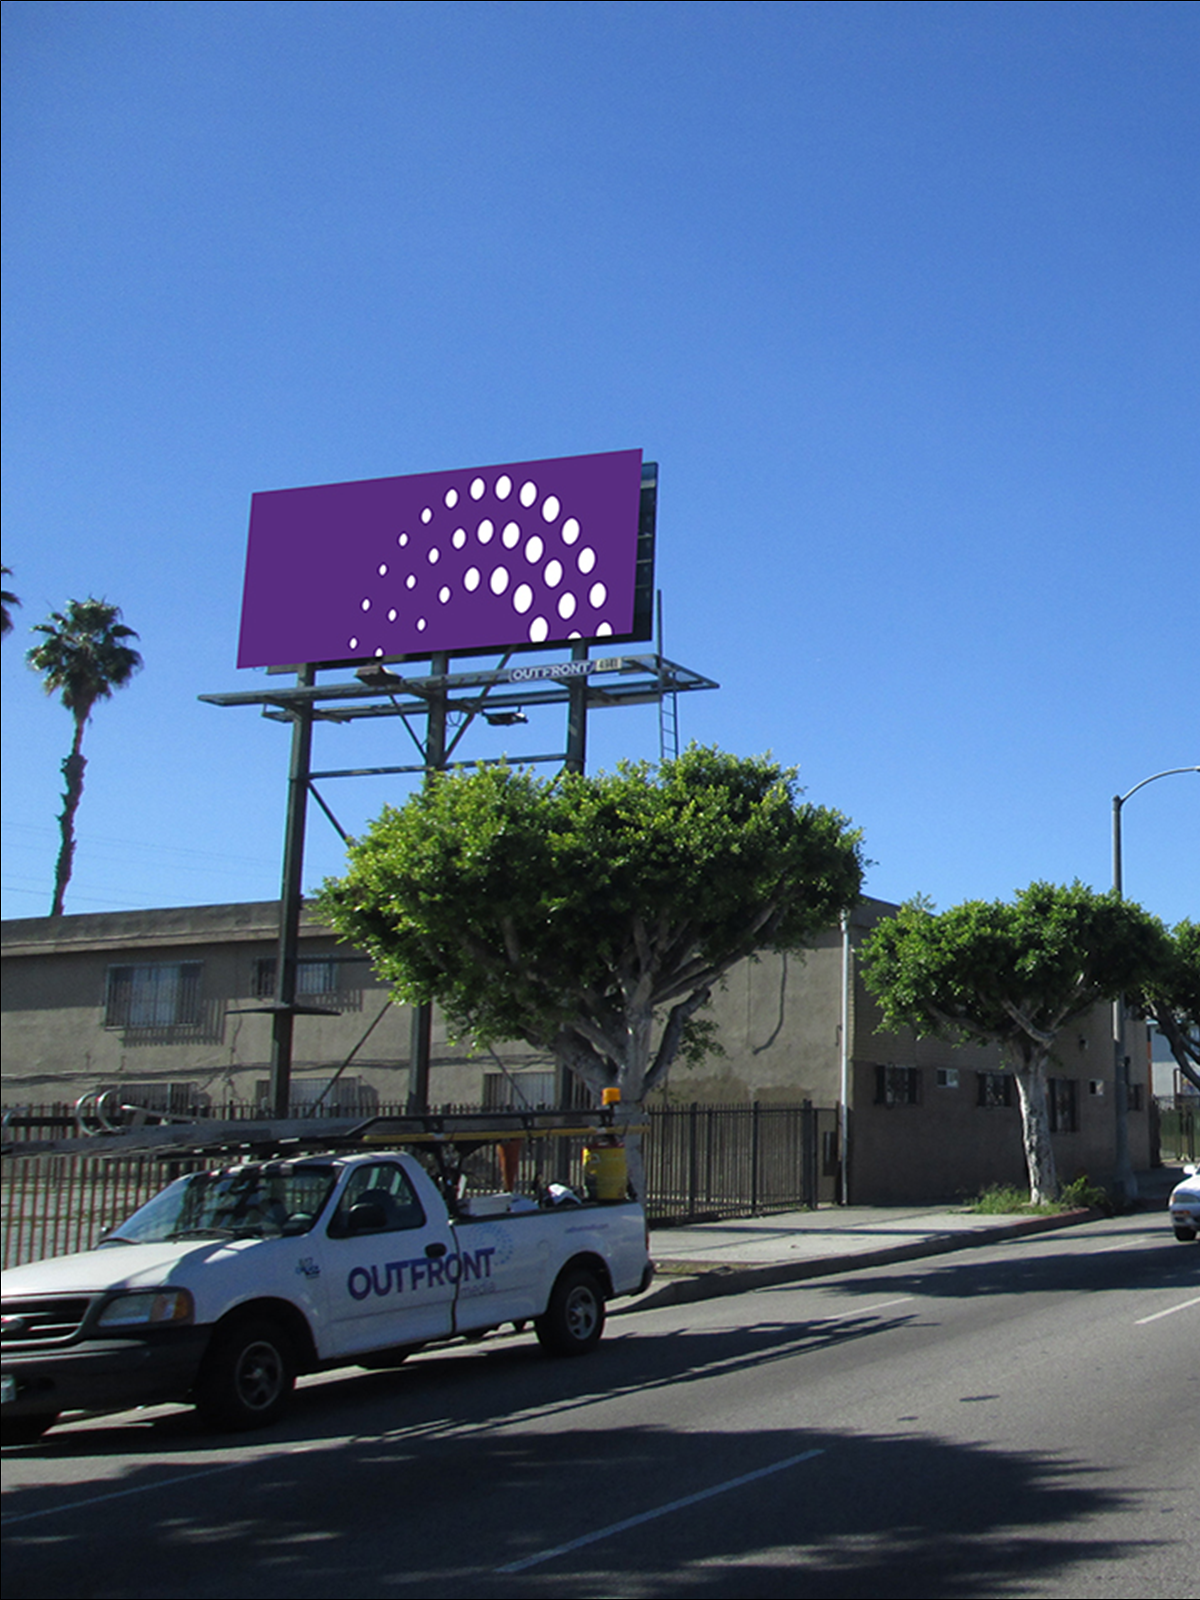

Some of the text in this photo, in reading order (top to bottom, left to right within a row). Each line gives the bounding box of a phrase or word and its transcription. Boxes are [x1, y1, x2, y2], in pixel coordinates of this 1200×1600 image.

[512, 661, 591, 681] OUTFRONT
[347, 1247, 496, 1301] OUTFRONT
[461, 1280, 496, 1298] media
